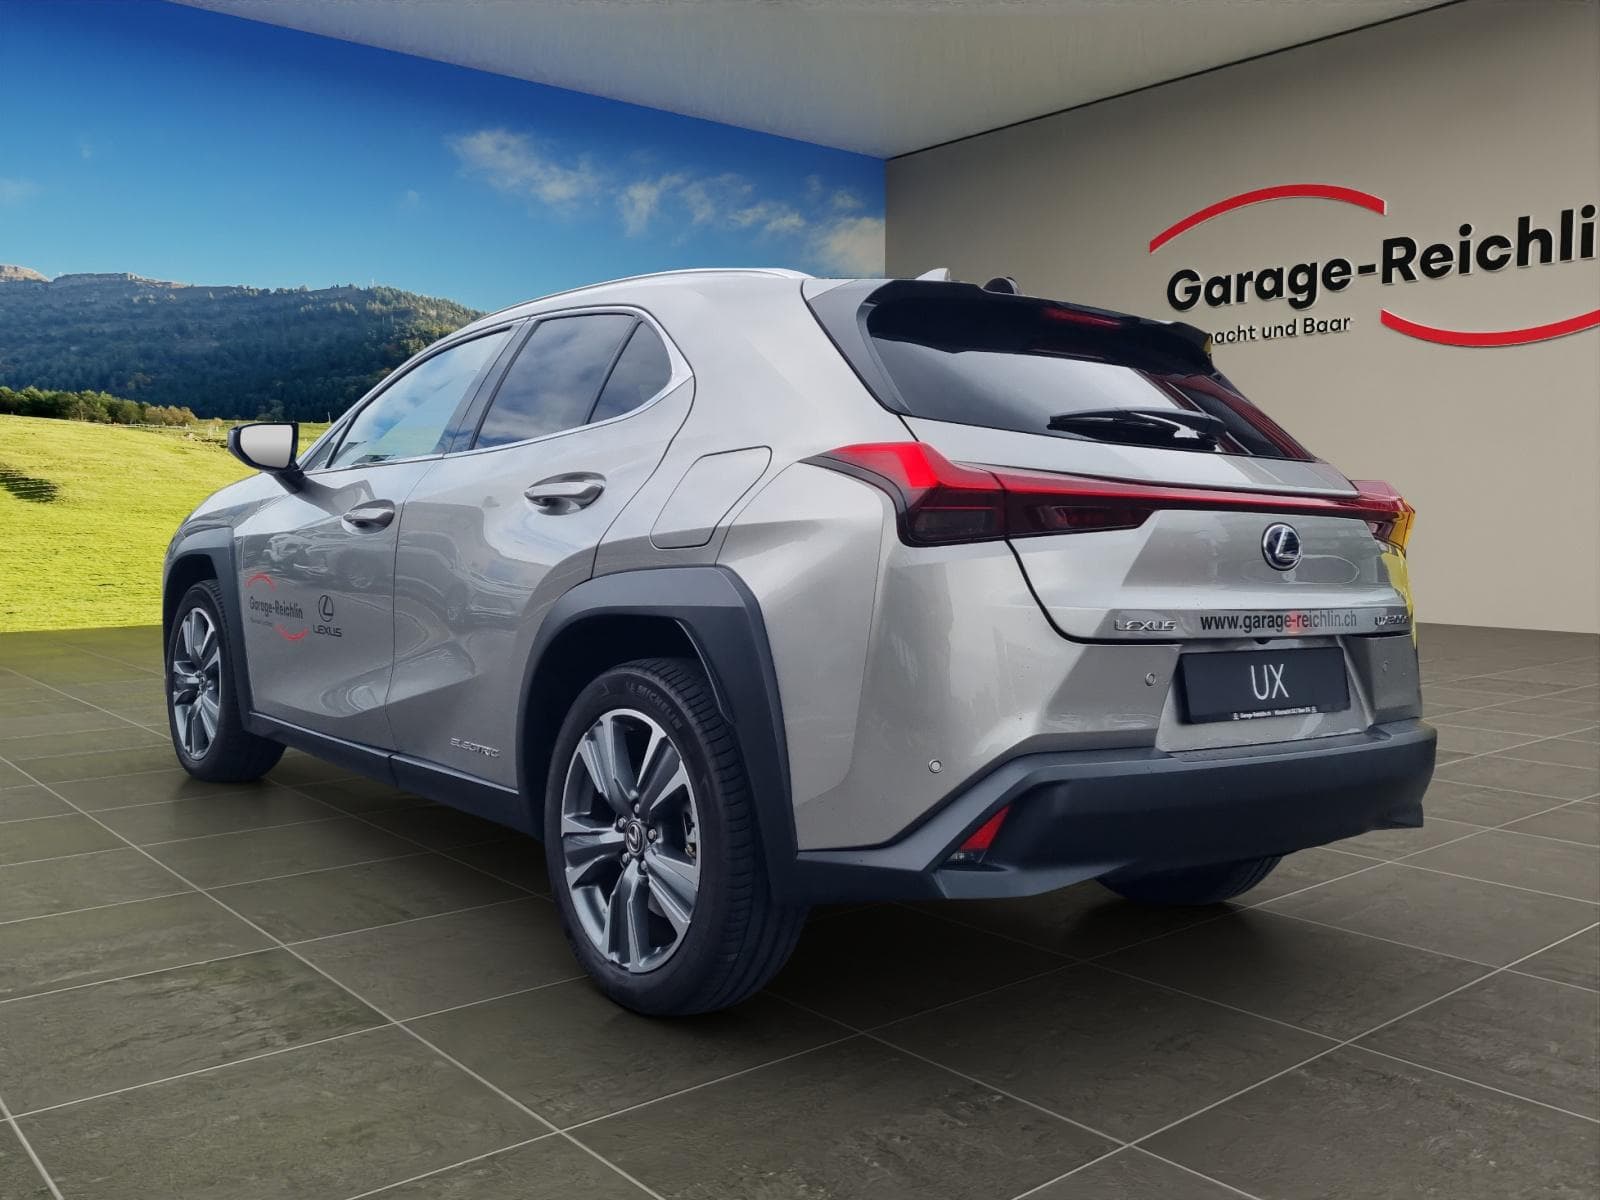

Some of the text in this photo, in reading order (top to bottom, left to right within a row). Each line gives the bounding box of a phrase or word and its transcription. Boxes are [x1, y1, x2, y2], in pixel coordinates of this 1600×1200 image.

[1262, 318, 1297, 339] und
[1303, 317, 1351, 335] Baar
[249, 595, 304, 620] Garage-Reichlin
[313, 624, 343, 638] LEXUS
[1114, 618, 1177, 632] LEXUS
[1200, 610, 1357, 634] www.garage-reichlin.ch
[1250, 663, 1290, 701] UX
[449, 736, 501, 759] ELECTRIC
